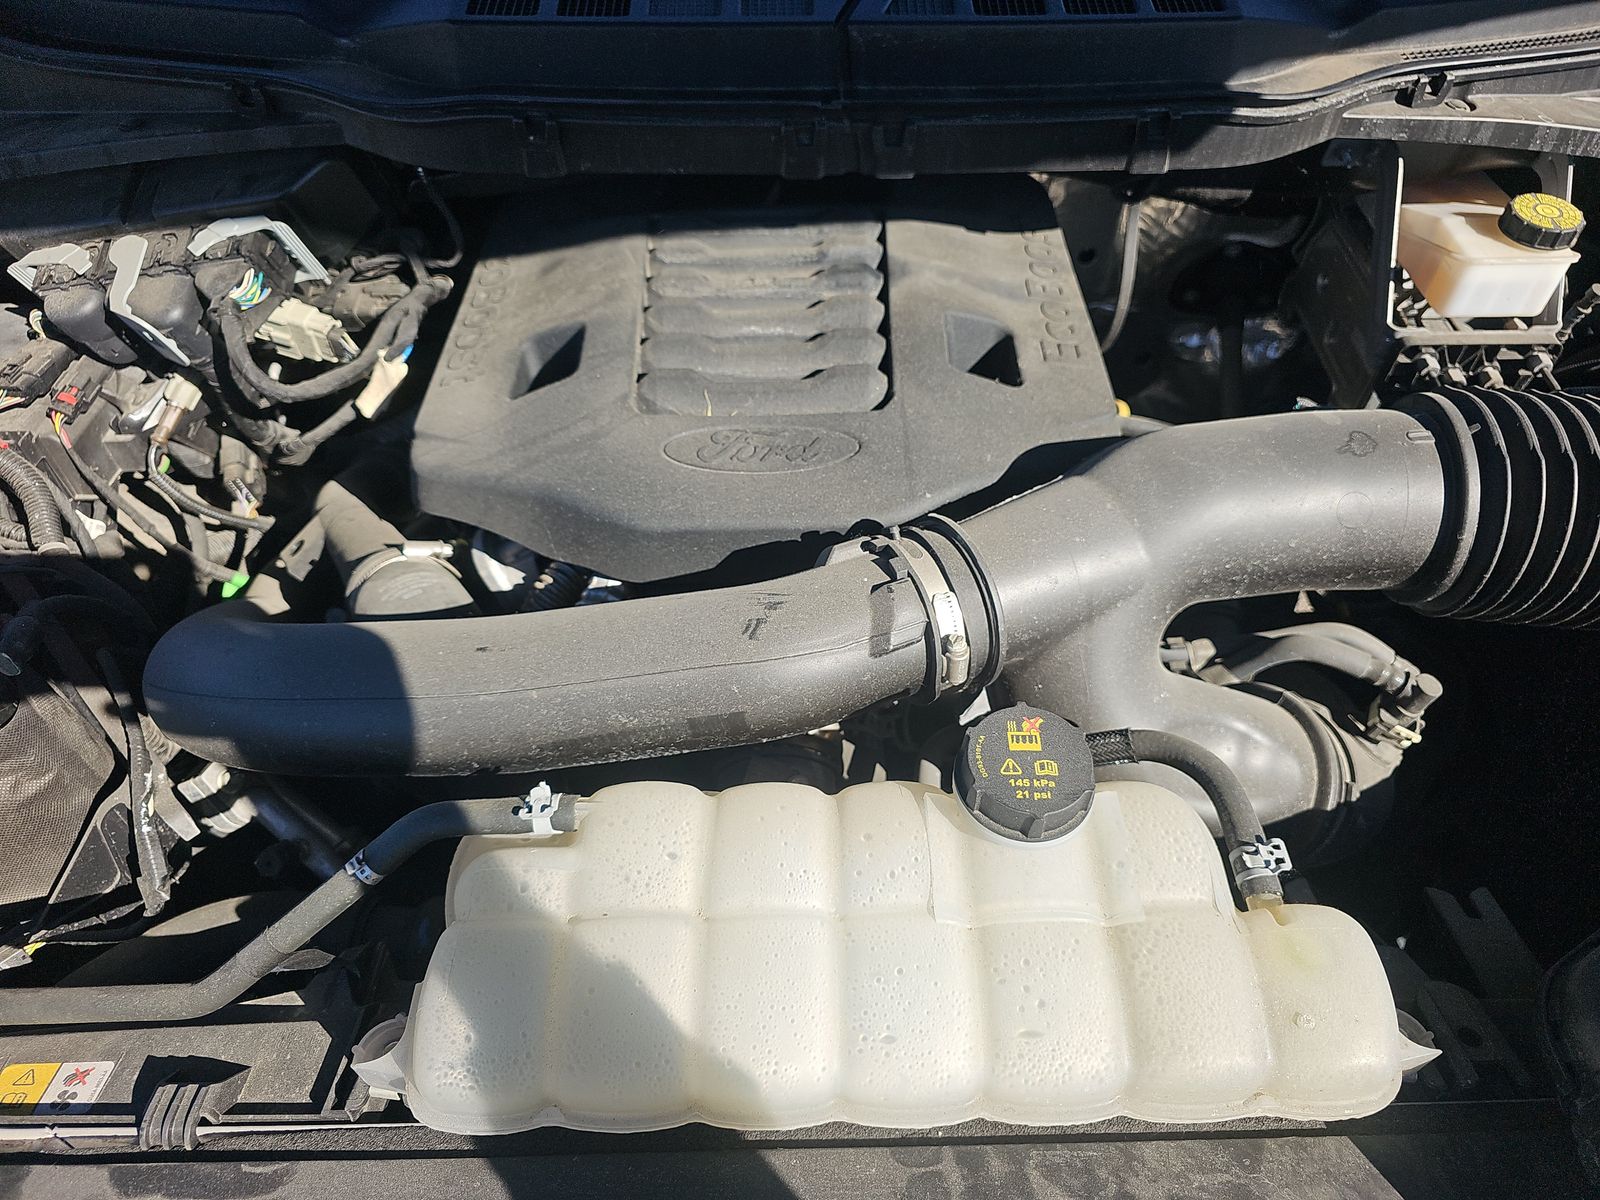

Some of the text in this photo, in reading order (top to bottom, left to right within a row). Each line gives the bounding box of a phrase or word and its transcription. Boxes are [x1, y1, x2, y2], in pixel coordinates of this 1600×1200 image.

[696, 428, 821, 464] Ford
[1008, 778, 1056, 788] 145 kPa
[1015, 790, 1052, 801] 21 psi
